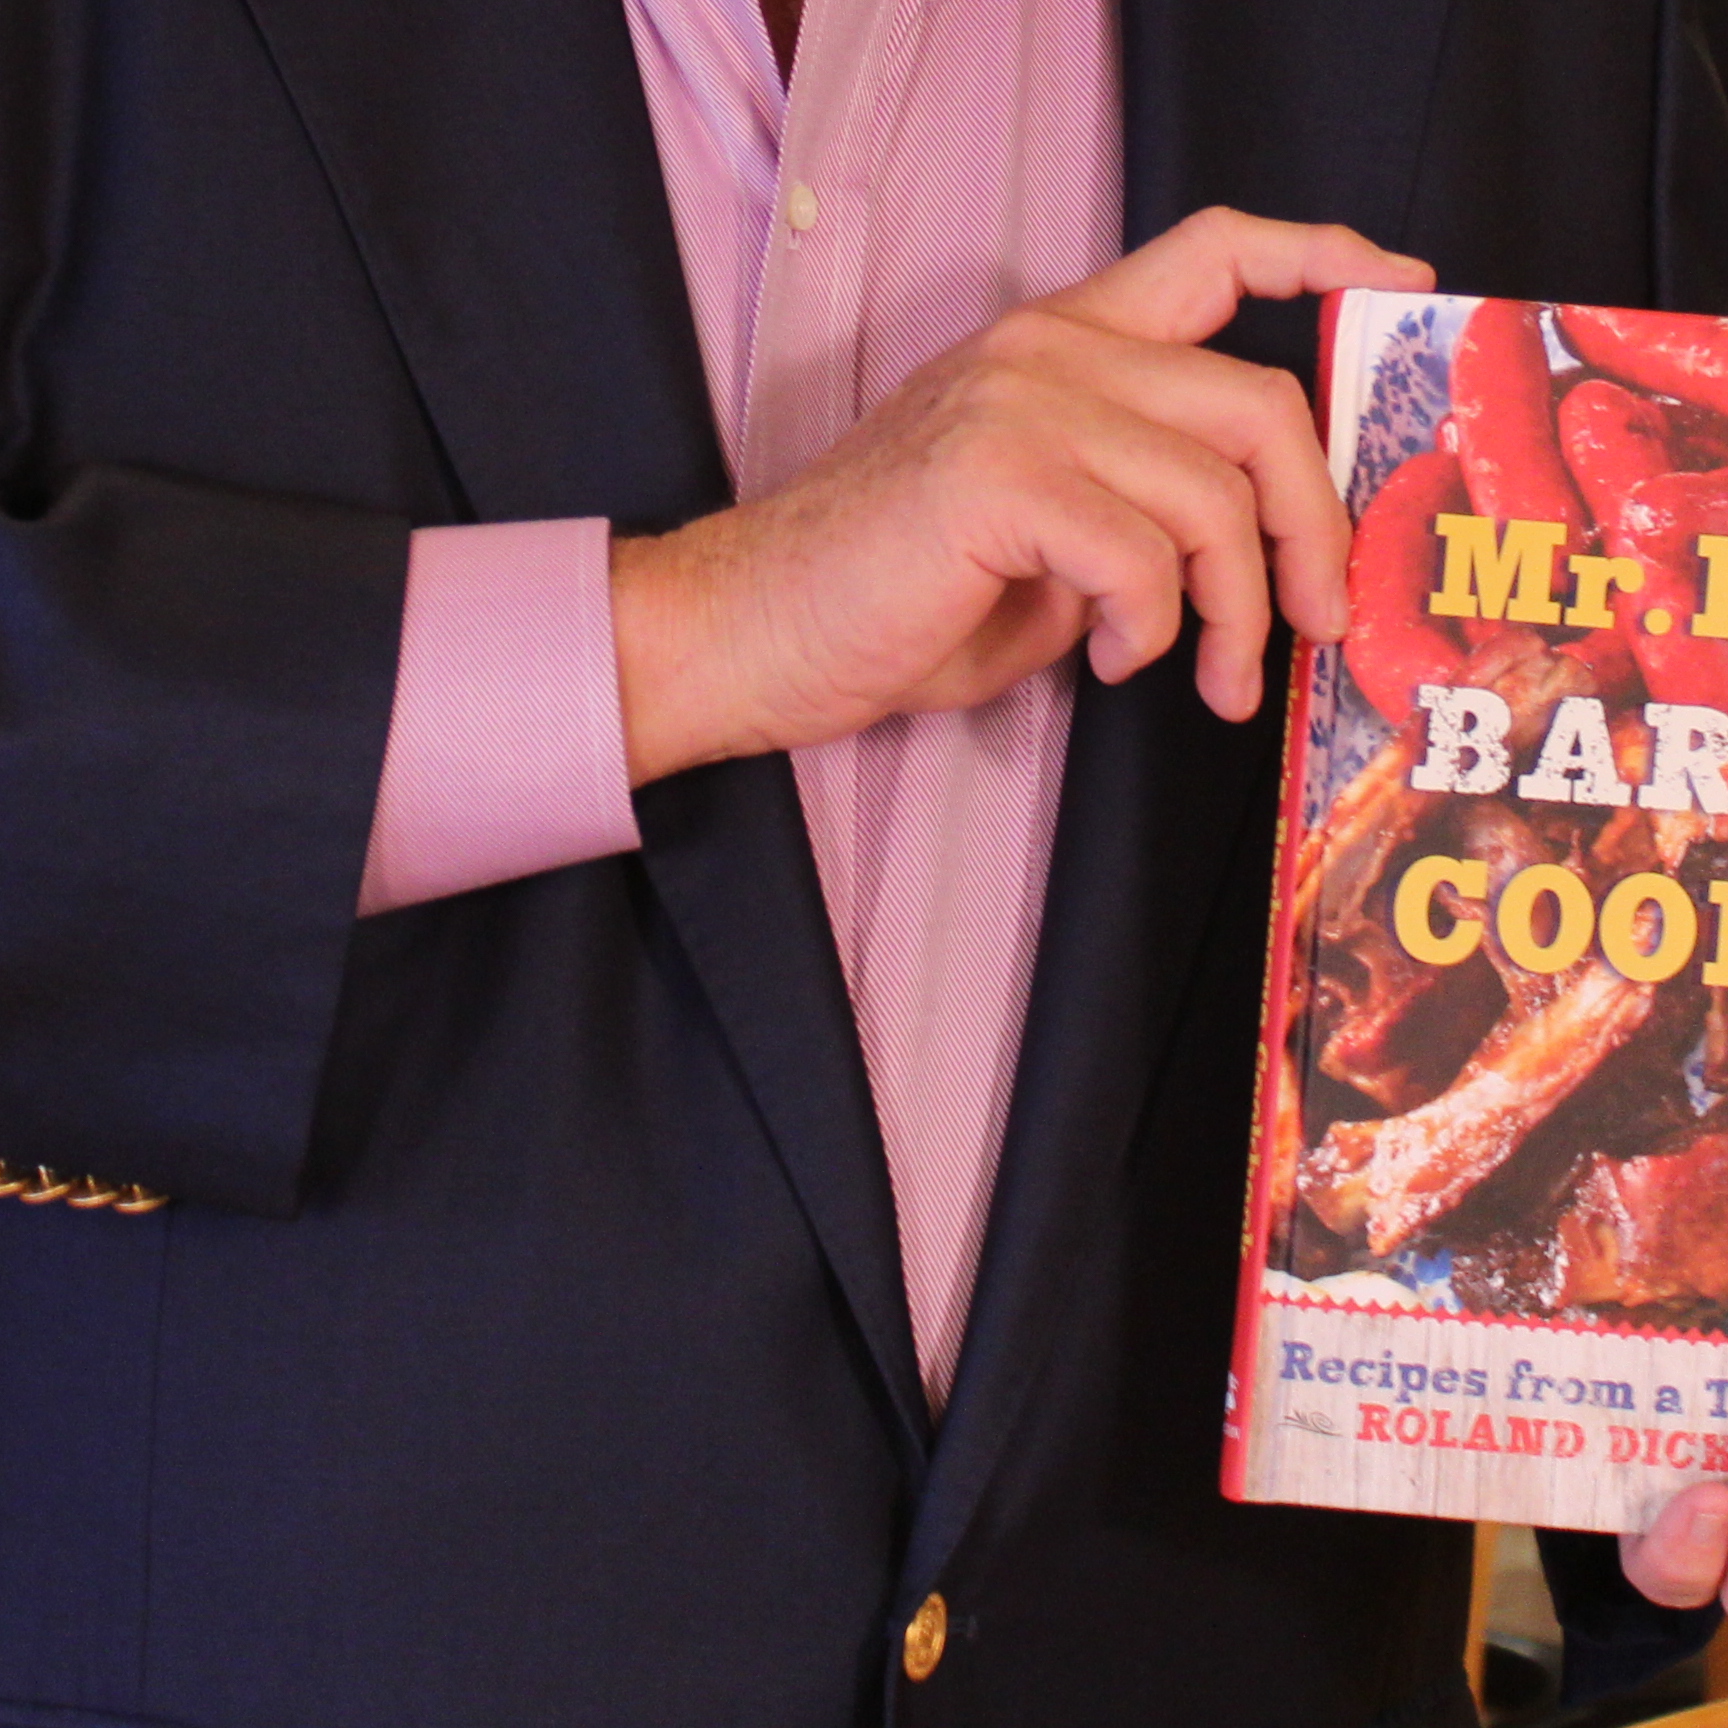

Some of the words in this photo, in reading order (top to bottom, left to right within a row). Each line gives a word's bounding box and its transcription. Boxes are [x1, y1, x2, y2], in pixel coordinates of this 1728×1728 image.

[1429, 514, 1673, 636] Mr.
[1281, 1341, 1488, 1404] Recipes
[1507, 1360, 1635, 1410] from
[1654, 1384, 1683, 1415] a
[1357, 1403, 1586, 1460] ROLAND
